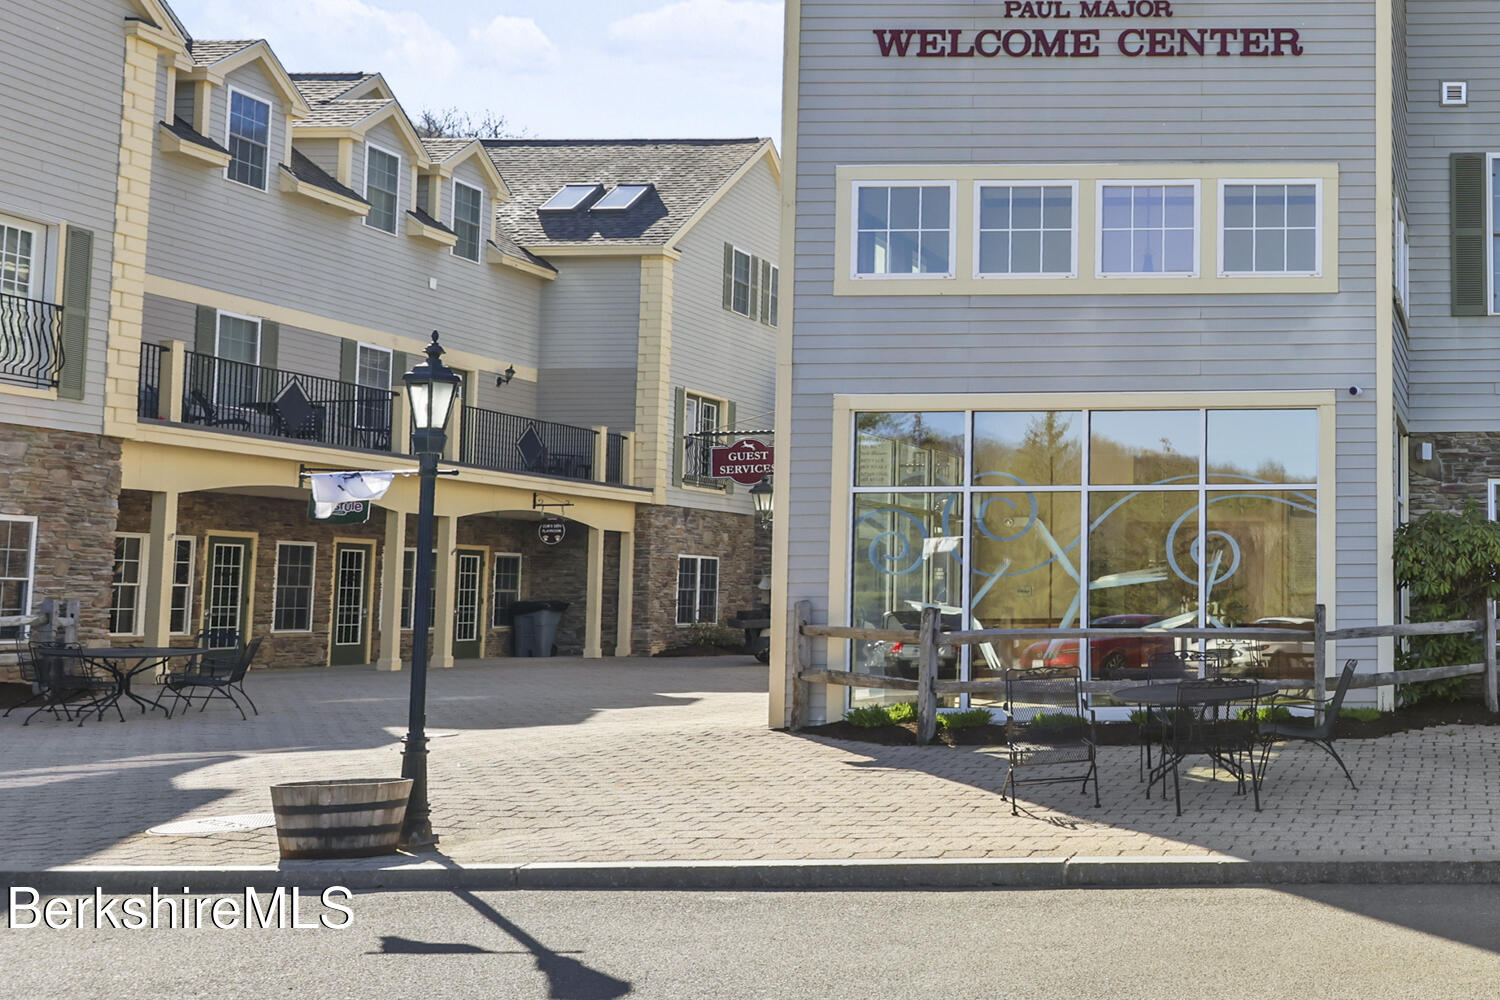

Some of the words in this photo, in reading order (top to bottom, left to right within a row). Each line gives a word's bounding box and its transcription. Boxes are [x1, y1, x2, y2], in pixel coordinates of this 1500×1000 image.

[1004, 0, 1070, 18] PAUL
[1080, 0, 1173, 17] MAJOR
[873, 29, 1100, 58] WELCOME
[1118, 28, 1303, 57] CENTER
[728, 451, 769, 461] GUEST
